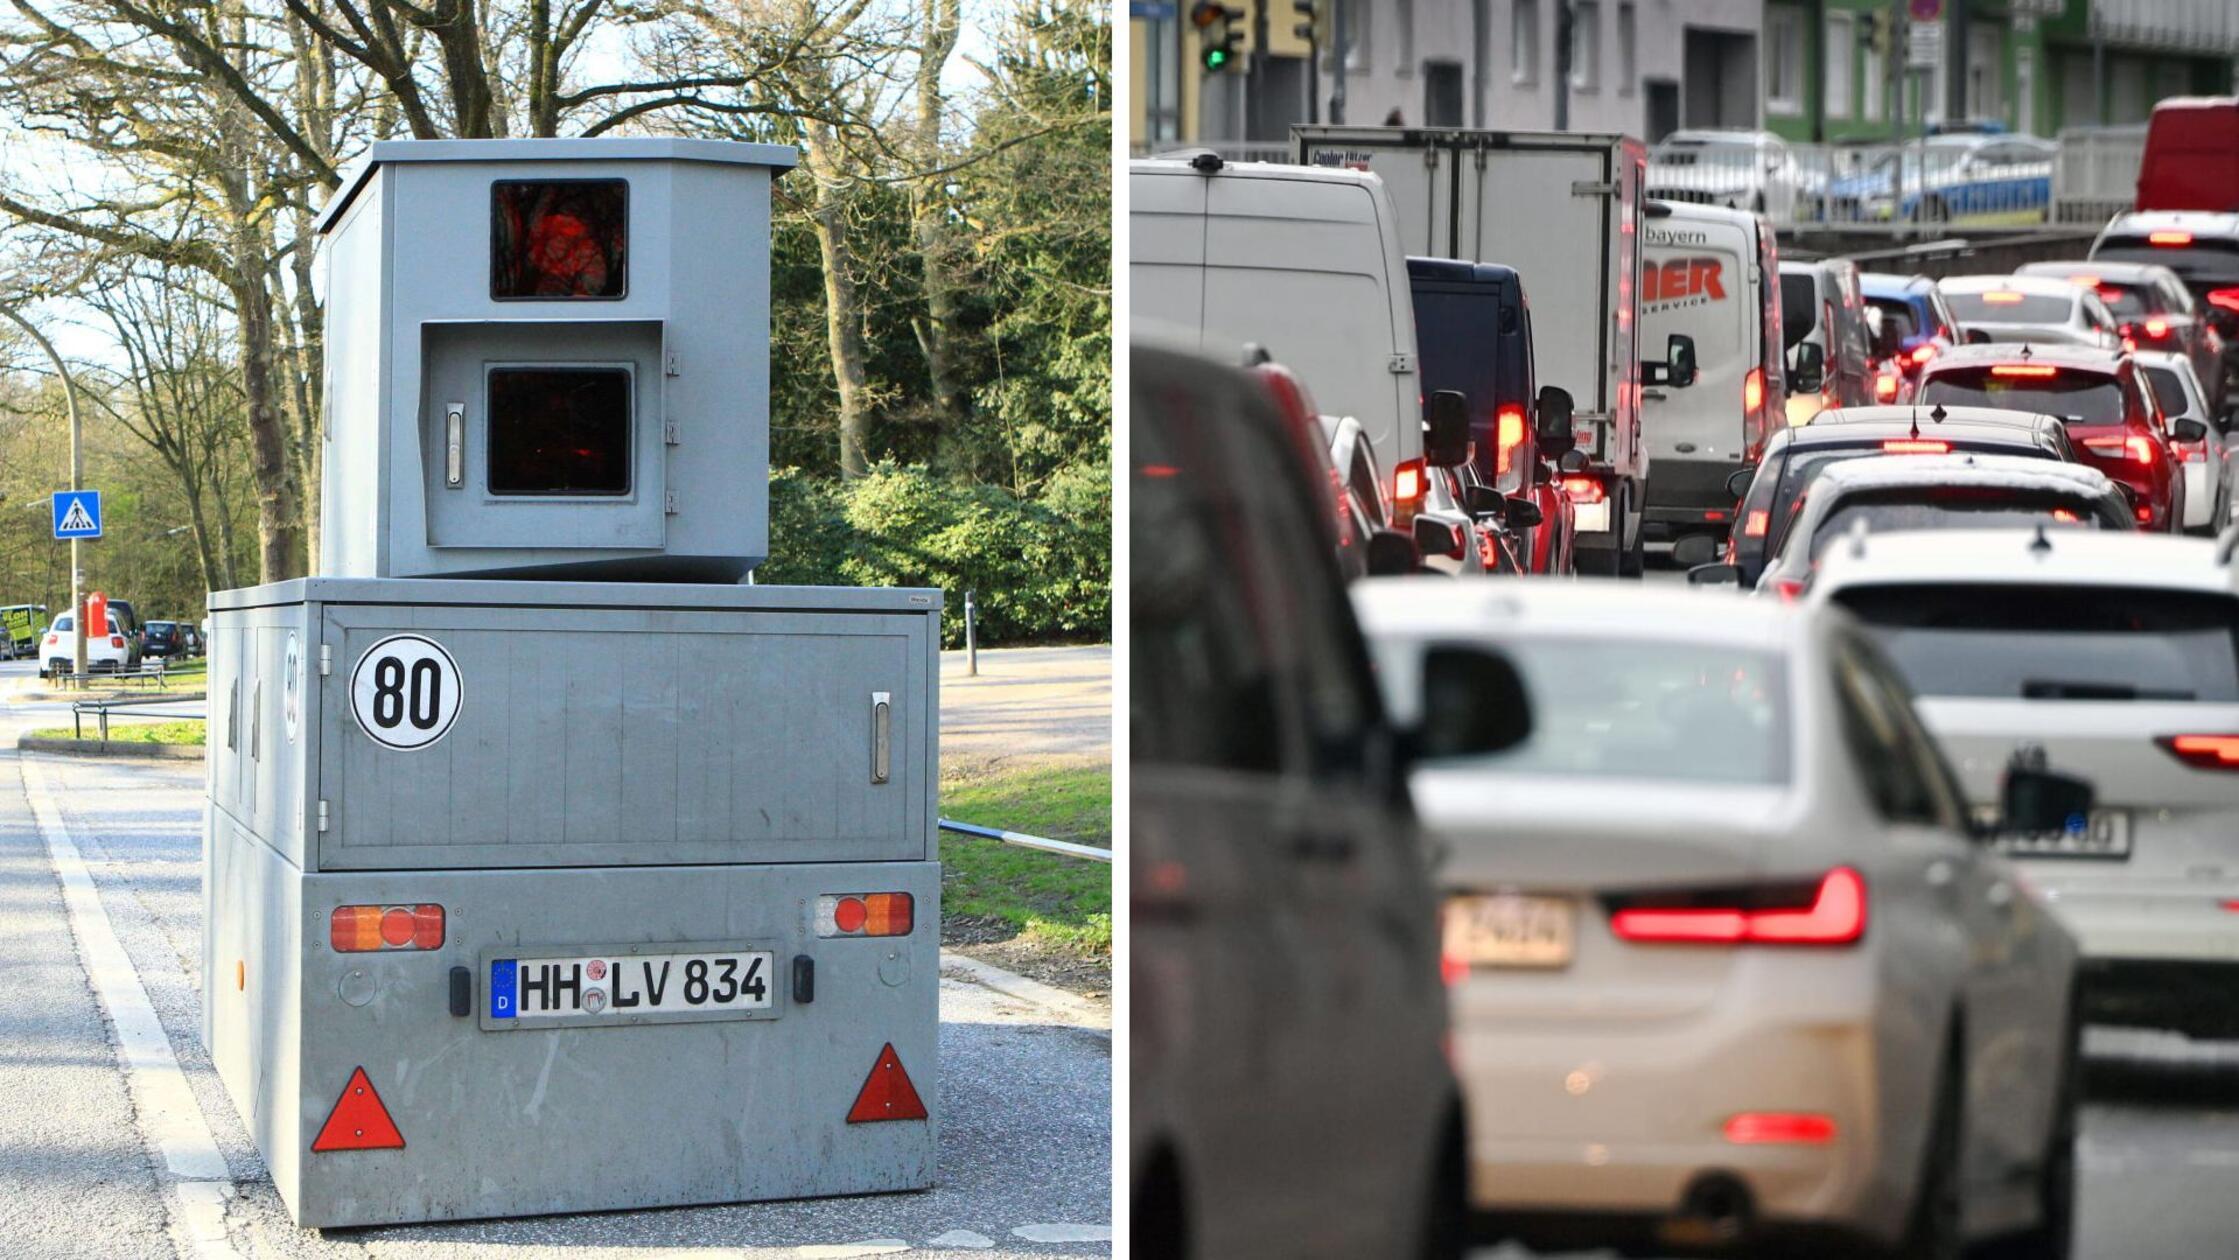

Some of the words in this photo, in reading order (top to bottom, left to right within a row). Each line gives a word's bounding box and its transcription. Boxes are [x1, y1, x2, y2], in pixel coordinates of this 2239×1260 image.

[373, 656, 442, 729] 80
[498, 996, 508, 1009] D
[521, 963, 581, 1011] HH
[612, 960, 670, 1008] LV
[684, 957, 766, 1005] 834
